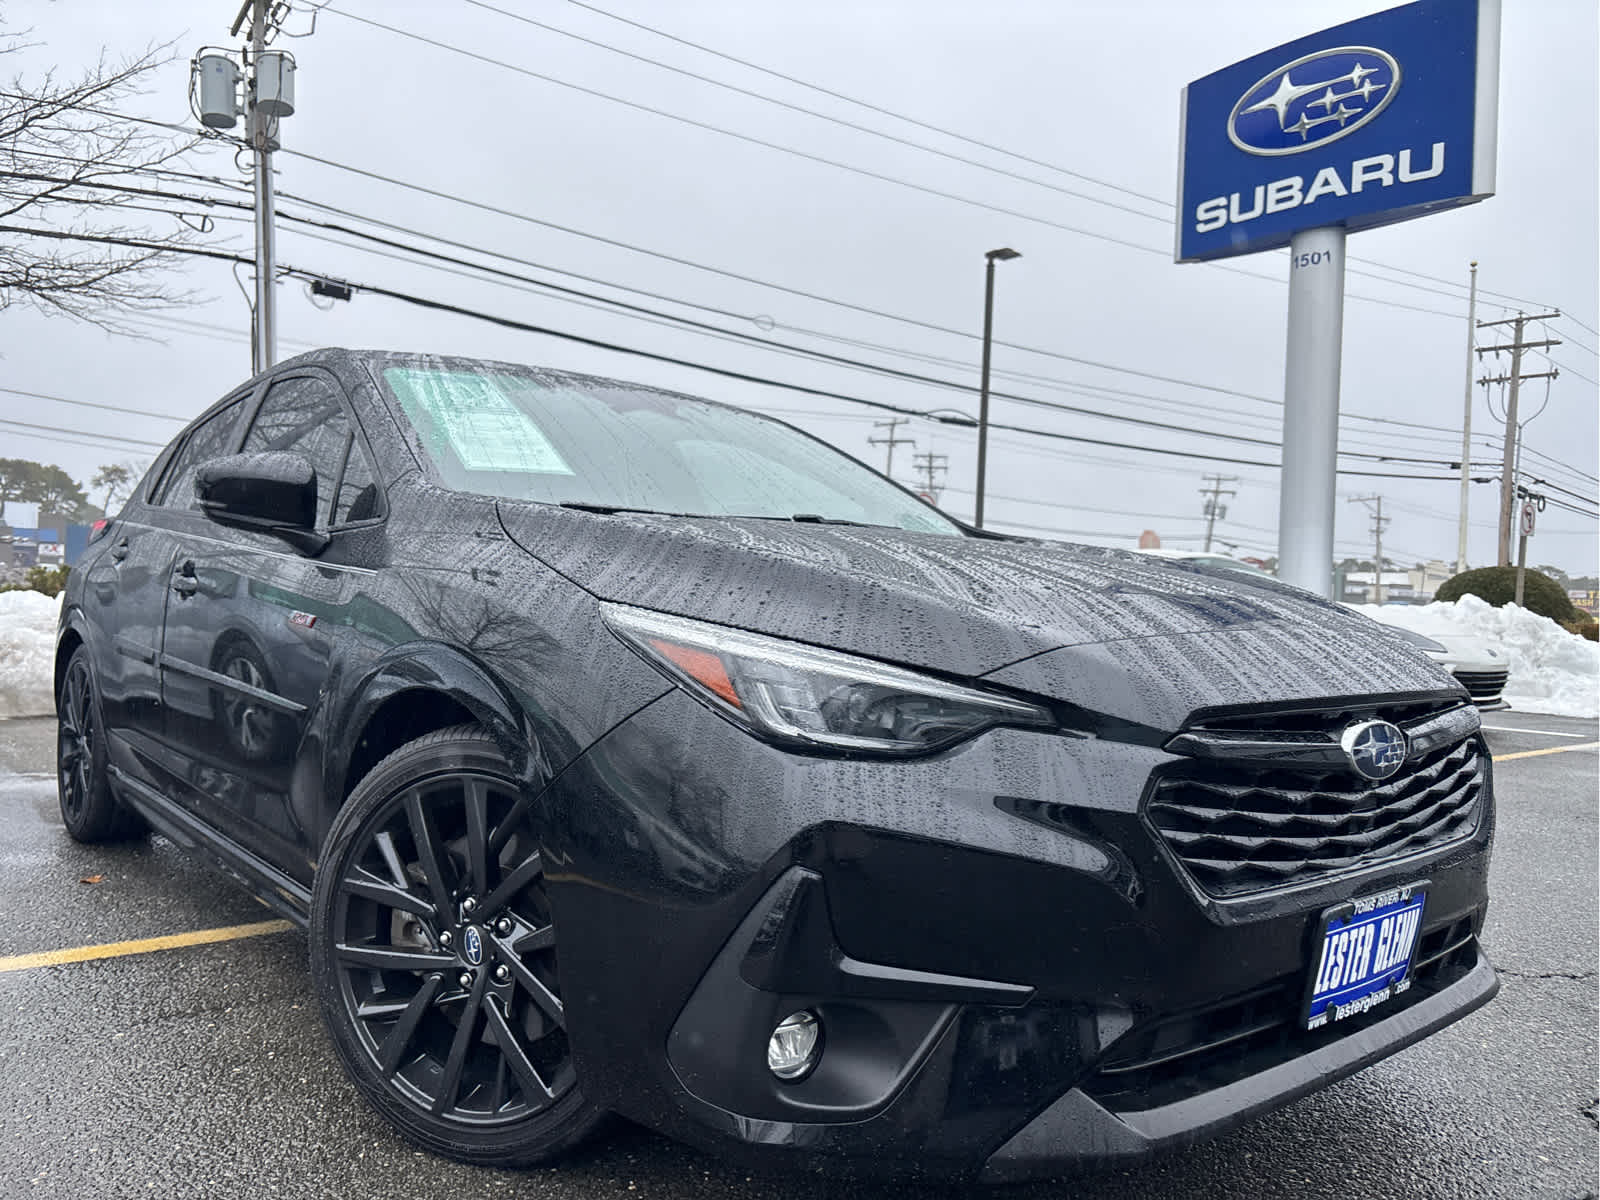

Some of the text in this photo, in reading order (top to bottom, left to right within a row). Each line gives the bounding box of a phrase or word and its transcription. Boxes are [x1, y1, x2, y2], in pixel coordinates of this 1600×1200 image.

[1195, 142, 1446, 233] SUBARU
[1294, 250, 1331, 269] 1501
[1354, 897, 1376, 916] TOMS
[1313, 908, 1420, 995] LESTER GLENN
[1335, 991, 1390, 1021] lesterglenn
